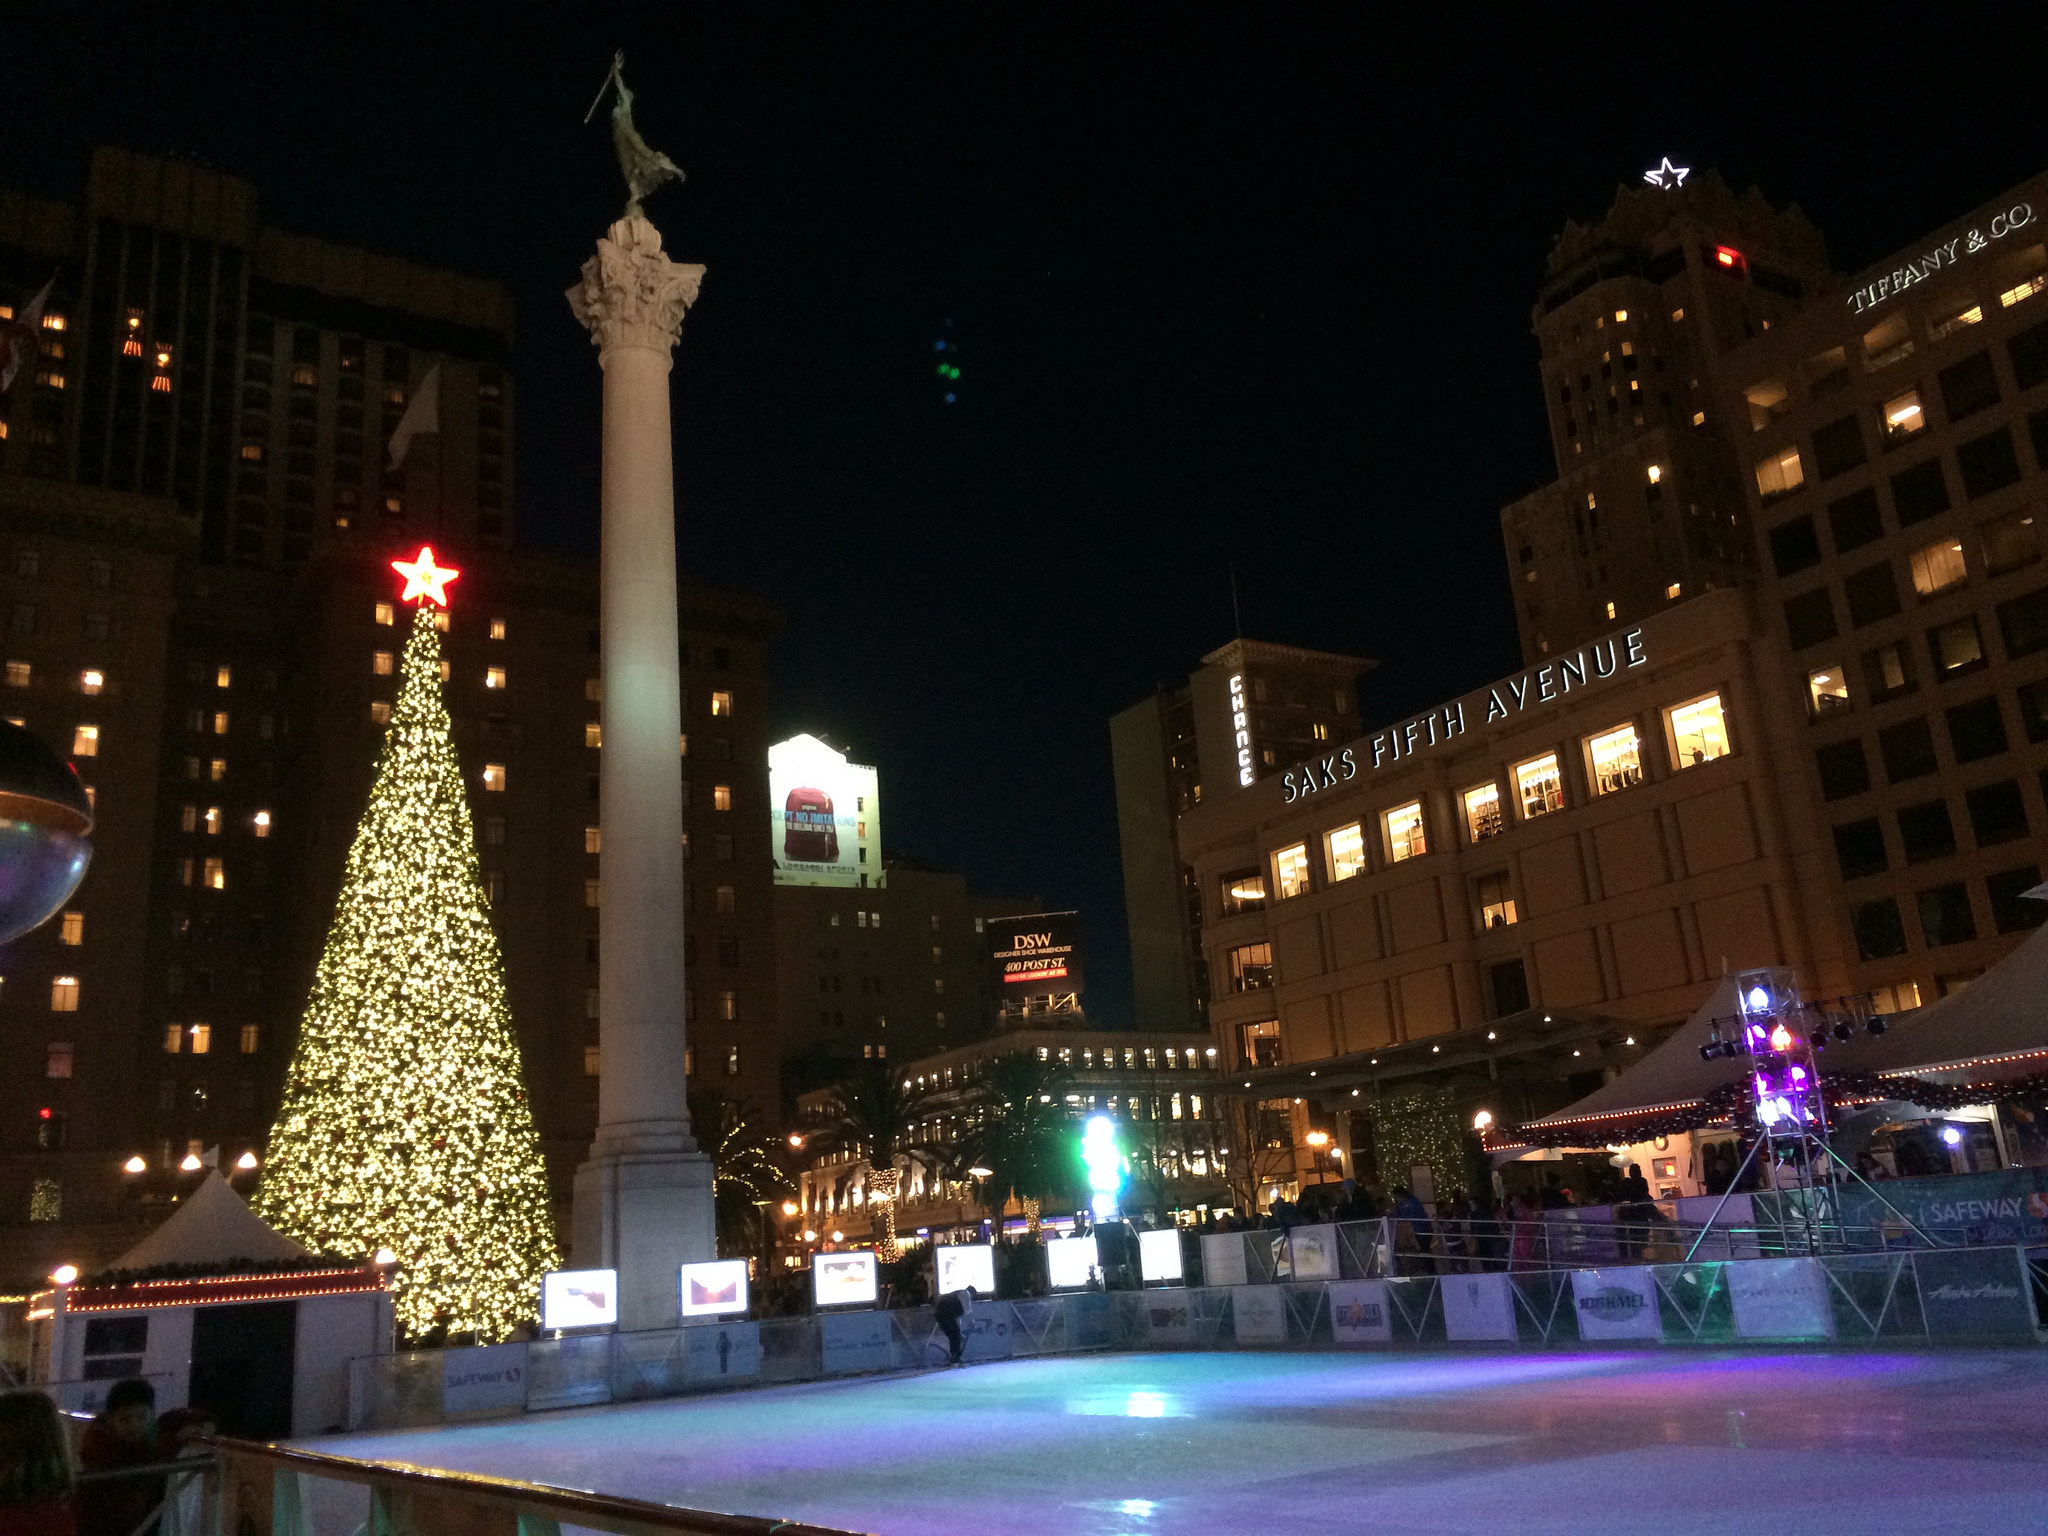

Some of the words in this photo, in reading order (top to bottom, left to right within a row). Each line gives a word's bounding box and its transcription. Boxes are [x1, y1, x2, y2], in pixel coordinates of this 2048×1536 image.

[1847, 238, 1959, 314] TIFFANY
[1965, 228, 1989, 254] &
[1989, 203, 2037, 239] CO.
[1280, 747, 1357, 804] SAKS
[1372, 702, 1466, 769] FIFTH
[1486, 628, 1648, 723] AVENUE
[1229, 674, 1253, 787] CHANCE
[795, 811, 808, 823] NO
[1013, 932, 1052, 950] DSW
[993, 950, 1020, 959] DESIGNER
[1037, 945, 1073, 954] WAREHOUSE
[1005, 961, 1022, 973] 400
[1022, 958, 1051, 971] POST
[1051, 957, 1066, 968] ST.
[1930, 1196, 2022, 1223] SAFEWAY
[447, 1370, 505, 1388] SAFEWAY
